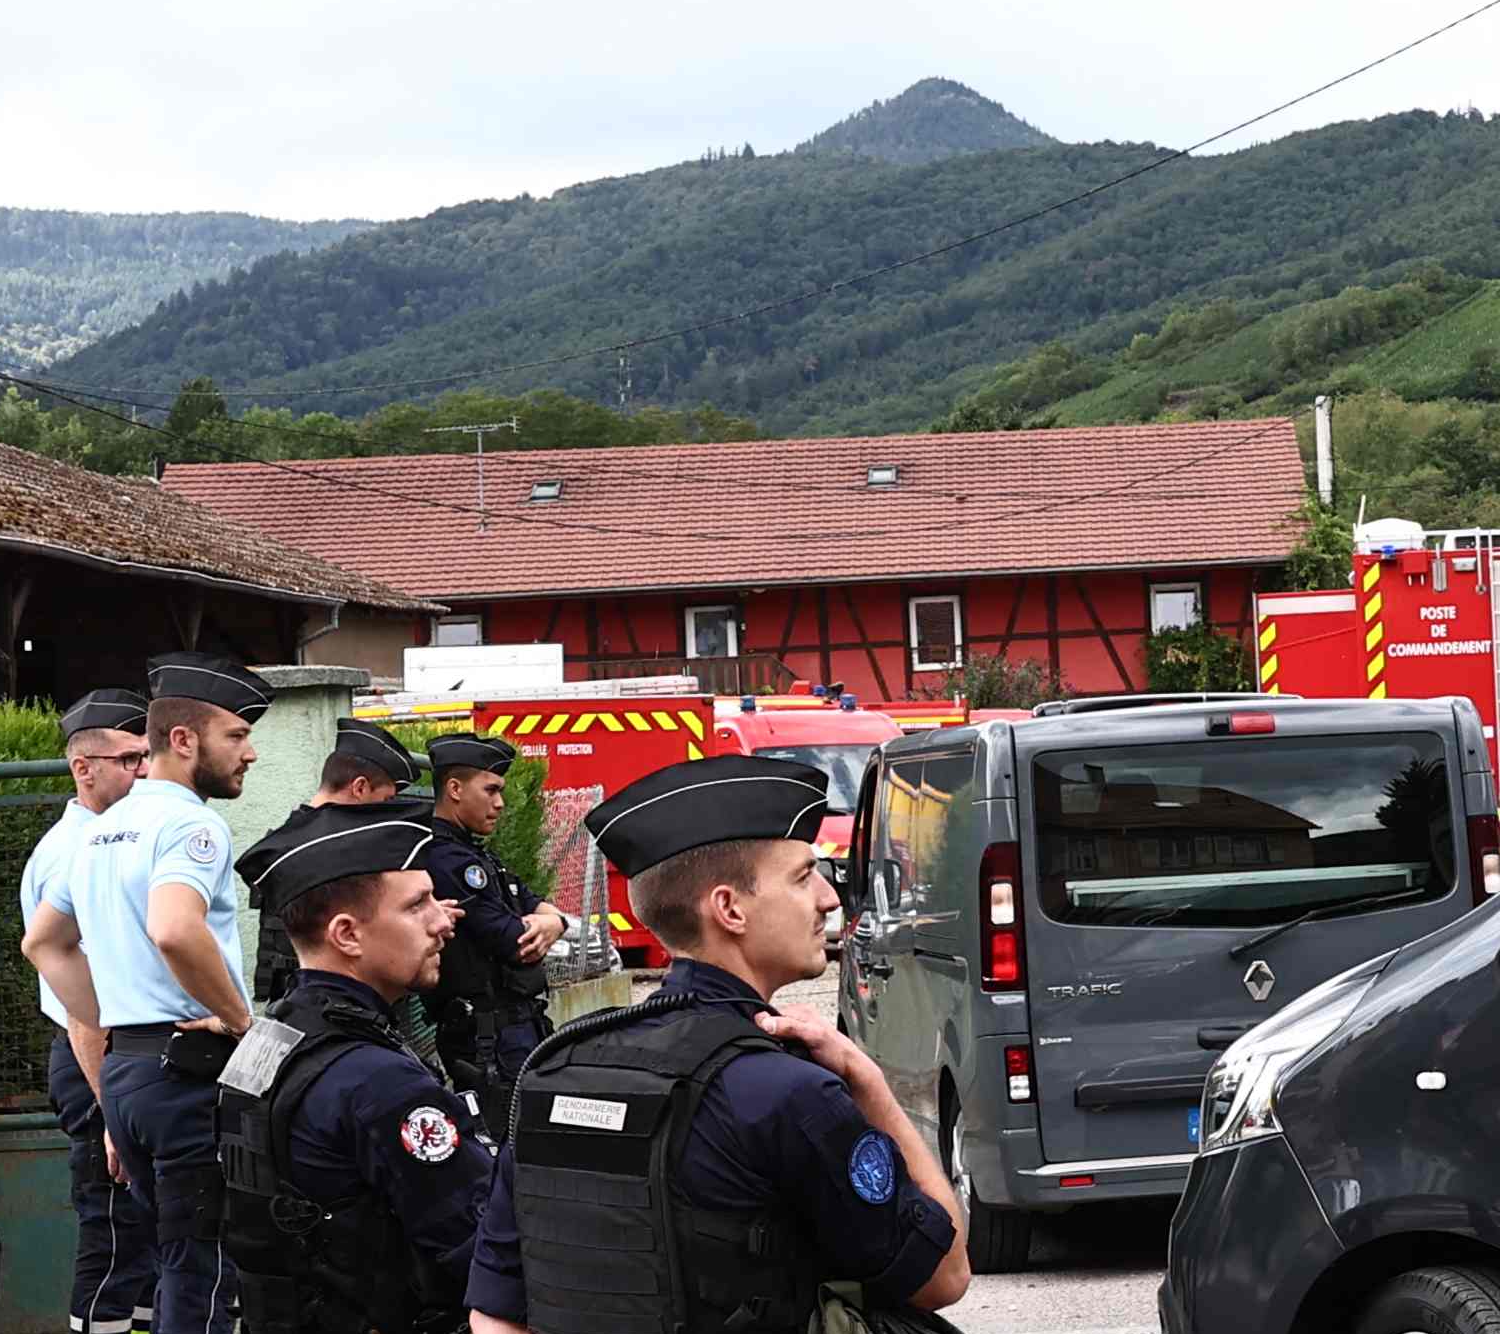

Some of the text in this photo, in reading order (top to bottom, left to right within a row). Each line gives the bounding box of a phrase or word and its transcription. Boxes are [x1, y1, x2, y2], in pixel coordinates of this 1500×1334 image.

[1419, 605, 1457, 621] POSTE
[1430, 624, 1448, 638] DE
[1387, 640, 1492, 658] COMMANDEMENT
[556, 743, 593, 756] PROTECTION
[1046, 982, 1123, 998] TRAFIC
[563, 1109, 613, 1126] NATIONALE
